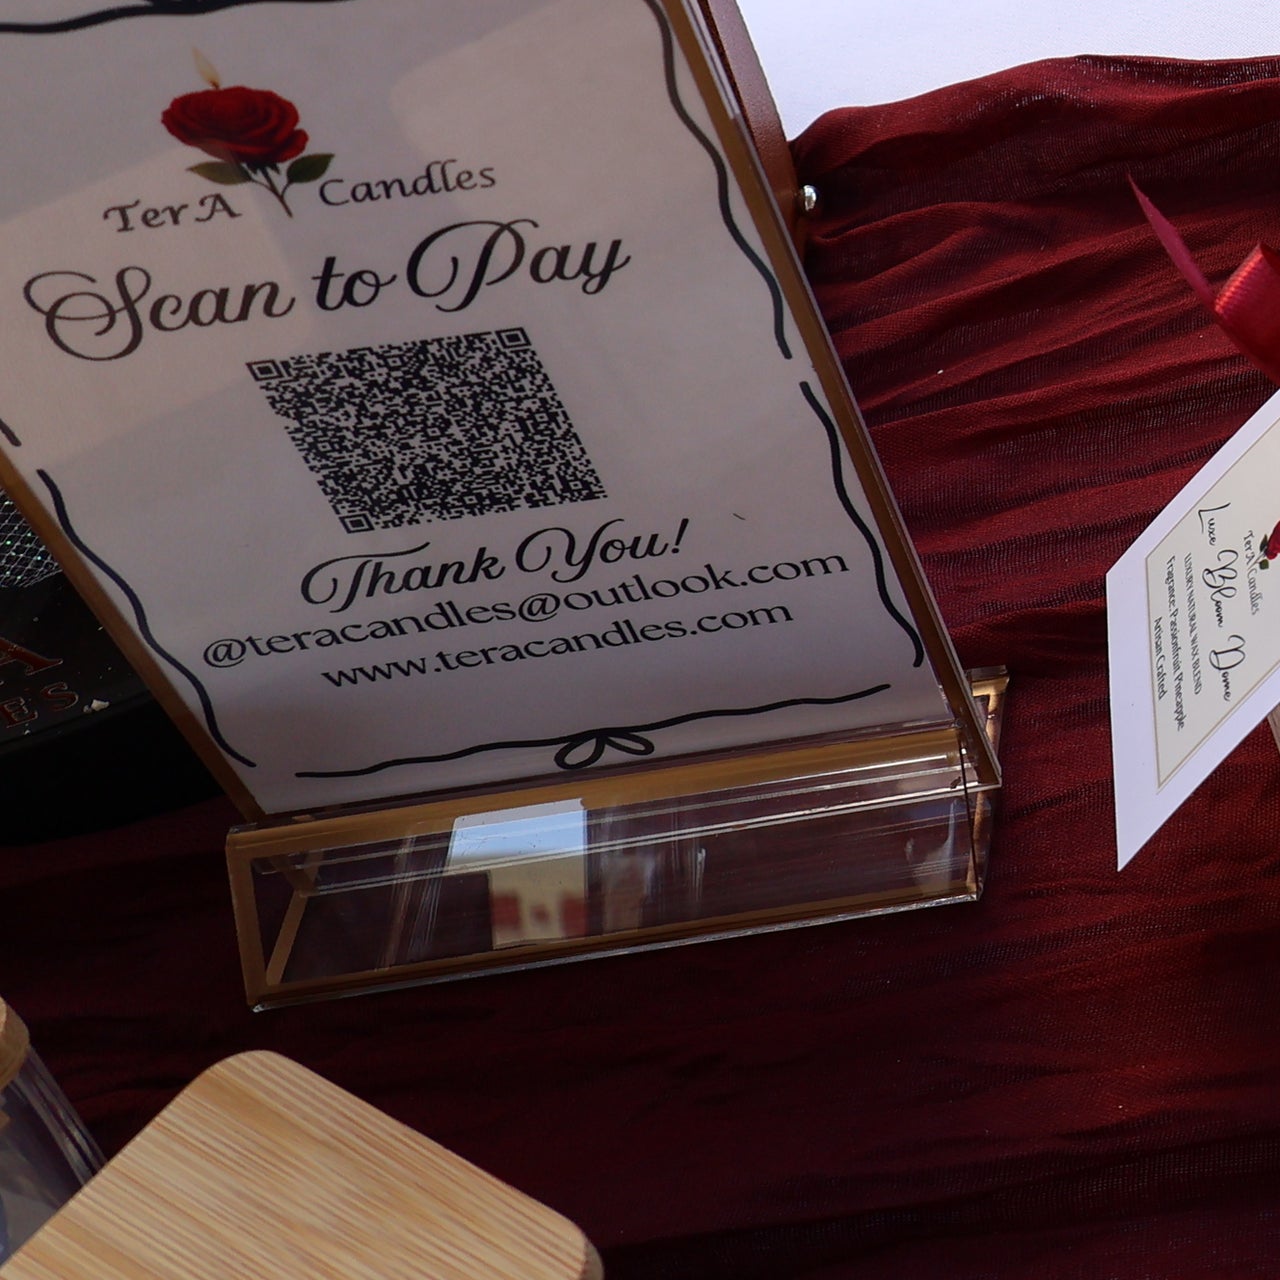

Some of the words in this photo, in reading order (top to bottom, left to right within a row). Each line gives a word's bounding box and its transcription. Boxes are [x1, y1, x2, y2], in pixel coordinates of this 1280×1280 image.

[318, 160, 496, 206] Candles
[23, 266, 295, 361] Scan
[312, 256, 396, 311] to
[406, 219, 631, 312] Pay
[1197, 502, 1231, 546] Luxe
[301, 542, 506, 613] Thank
[515, 518, 689, 579] You!
[1164, 555, 1176, 612] Fragrance:
[1184, 552, 1194, 592] LUXURY
[1202, 549, 1239, 628] Bloom
[1247, 559, 1263, 616] Candles
[203, 555, 849, 668] @teracandles@outlook.com
[1154, 616, 1164, 657] Artisan
[1187, 589, 1197, 637] NATURAL
[321, 606, 793, 687] www.teracandles.com
[1169, 607, 1182, 676] Passionfruit
[1190, 633, 1199, 661] WAX
[1209, 634, 1246, 702] Dome
[1156, 654, 1168, 701] Crafted
[1173, 671, 1187, 731] Pineapple
[1192, 657, 1202, 695] BLEND
